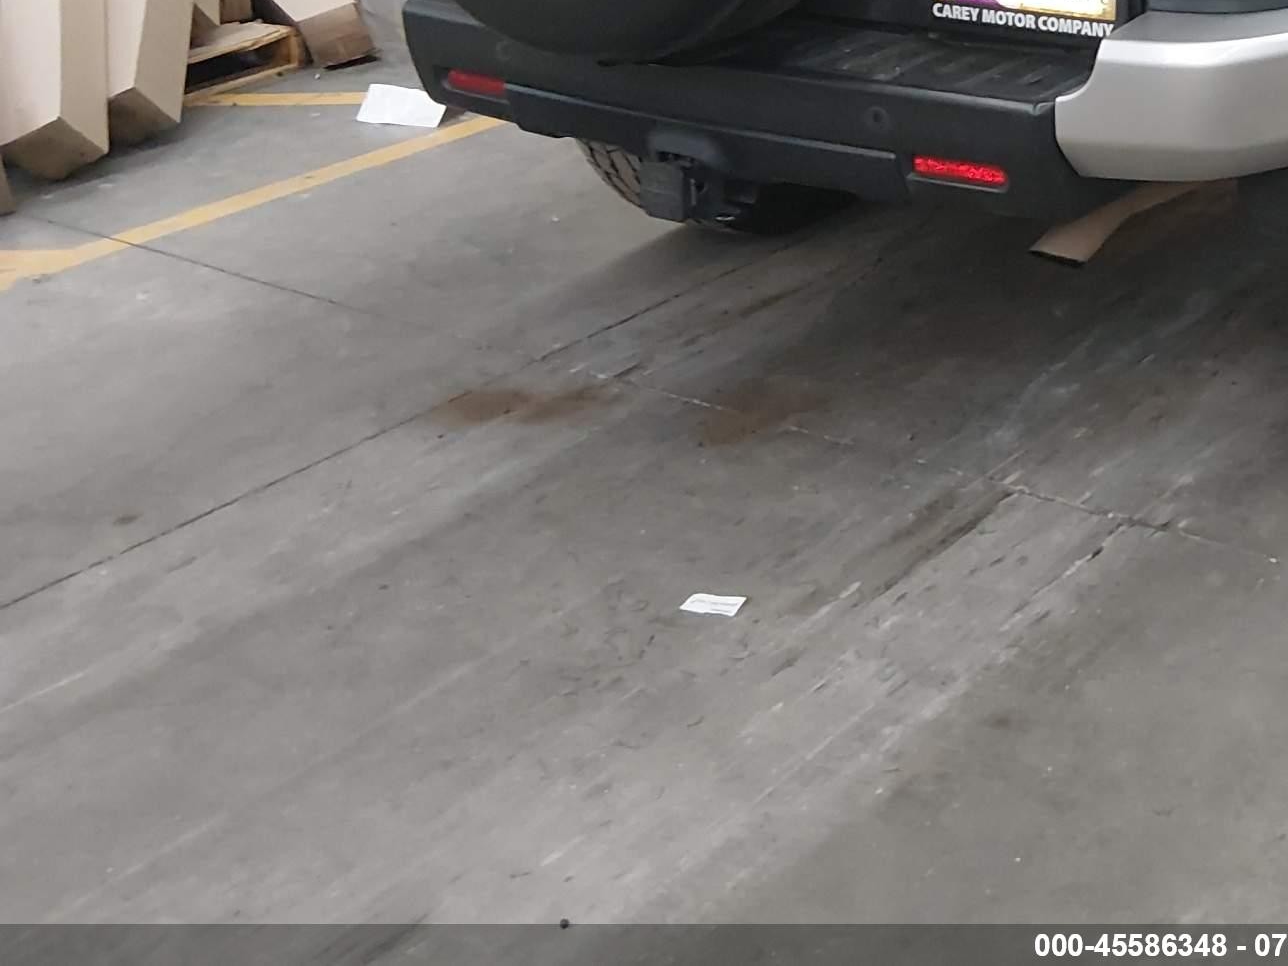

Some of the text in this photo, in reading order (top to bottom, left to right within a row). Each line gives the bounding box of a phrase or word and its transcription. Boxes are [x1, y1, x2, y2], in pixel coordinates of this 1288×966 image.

[932, 3, 1114, 37] CAREY MOTOR COMPANY
